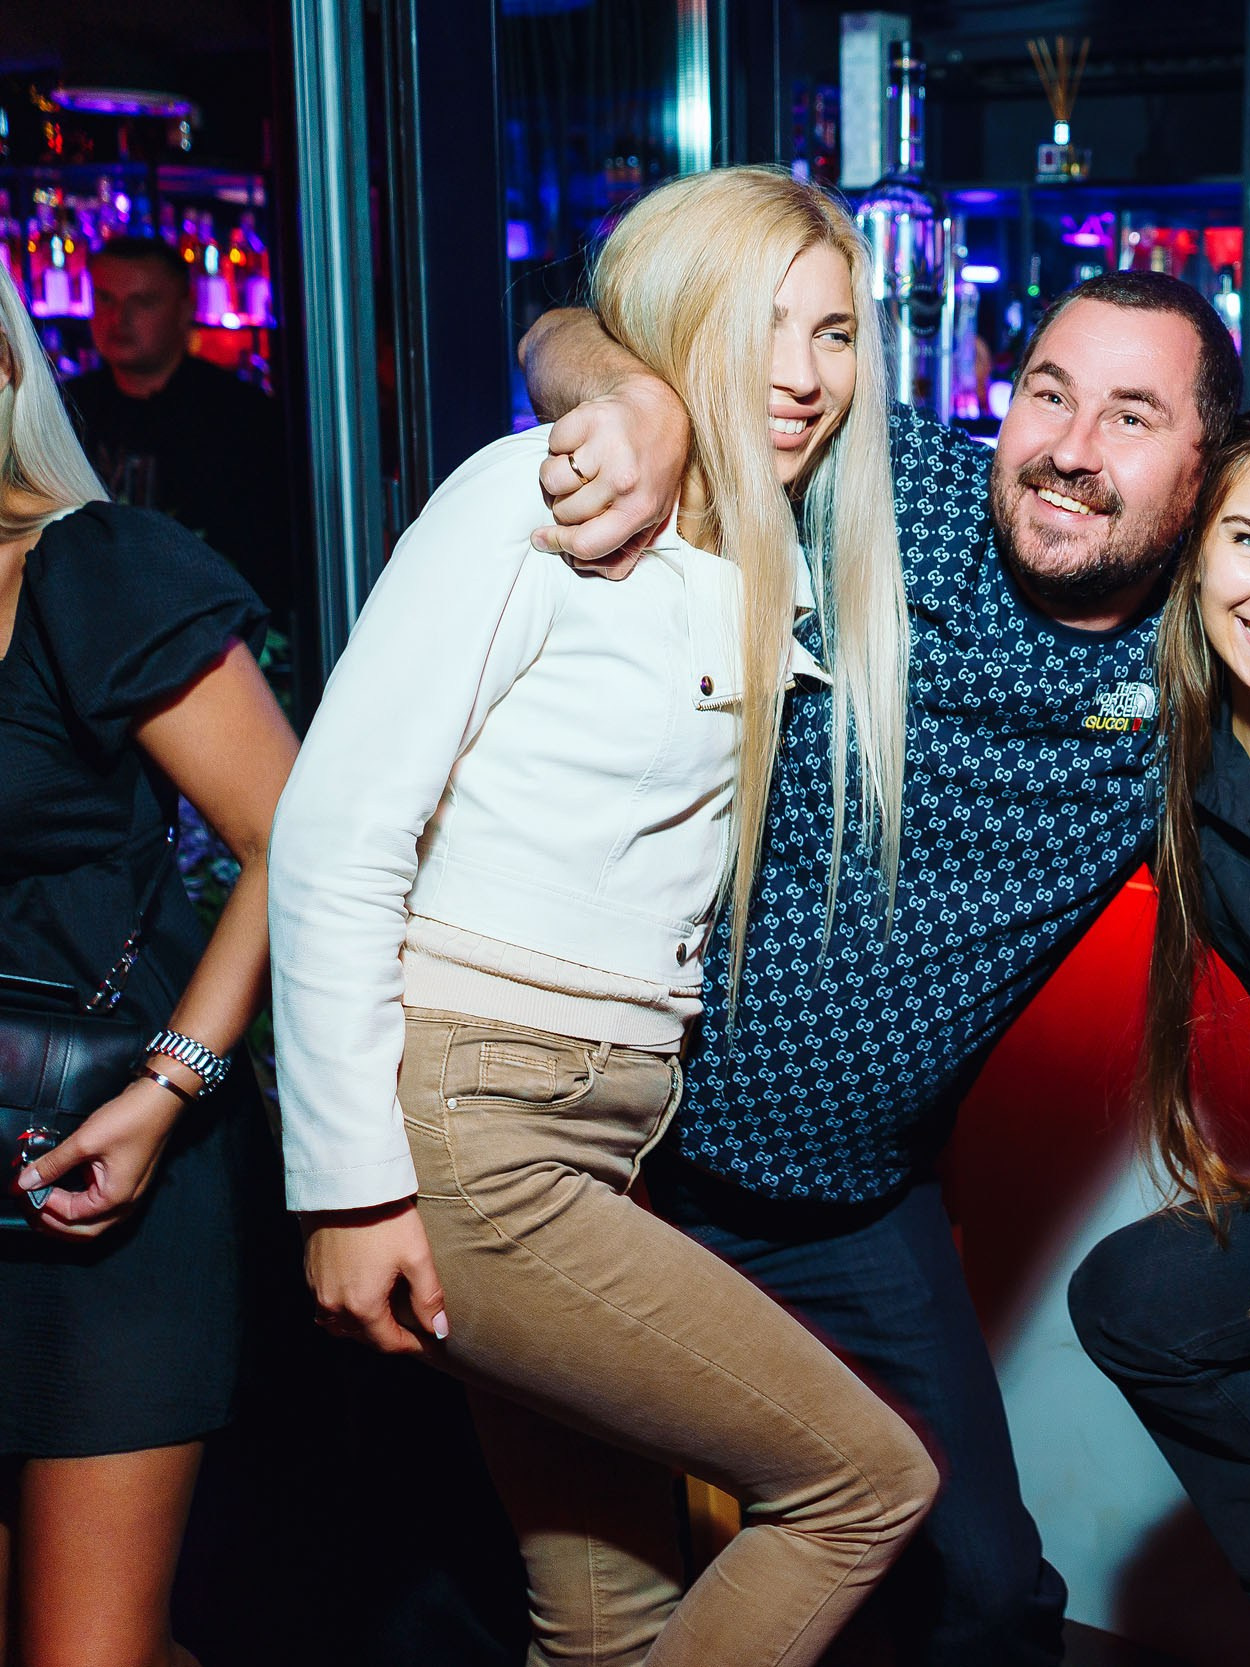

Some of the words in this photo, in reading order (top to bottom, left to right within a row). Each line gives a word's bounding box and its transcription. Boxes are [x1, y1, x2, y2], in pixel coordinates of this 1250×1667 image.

[1115, 682, 1139, 694] THE
[1092, 692, 1135, 706] NORTH
[1098, 705, 1133, 717] FACE
[1085, 715, 1128, 731] GUCCI
